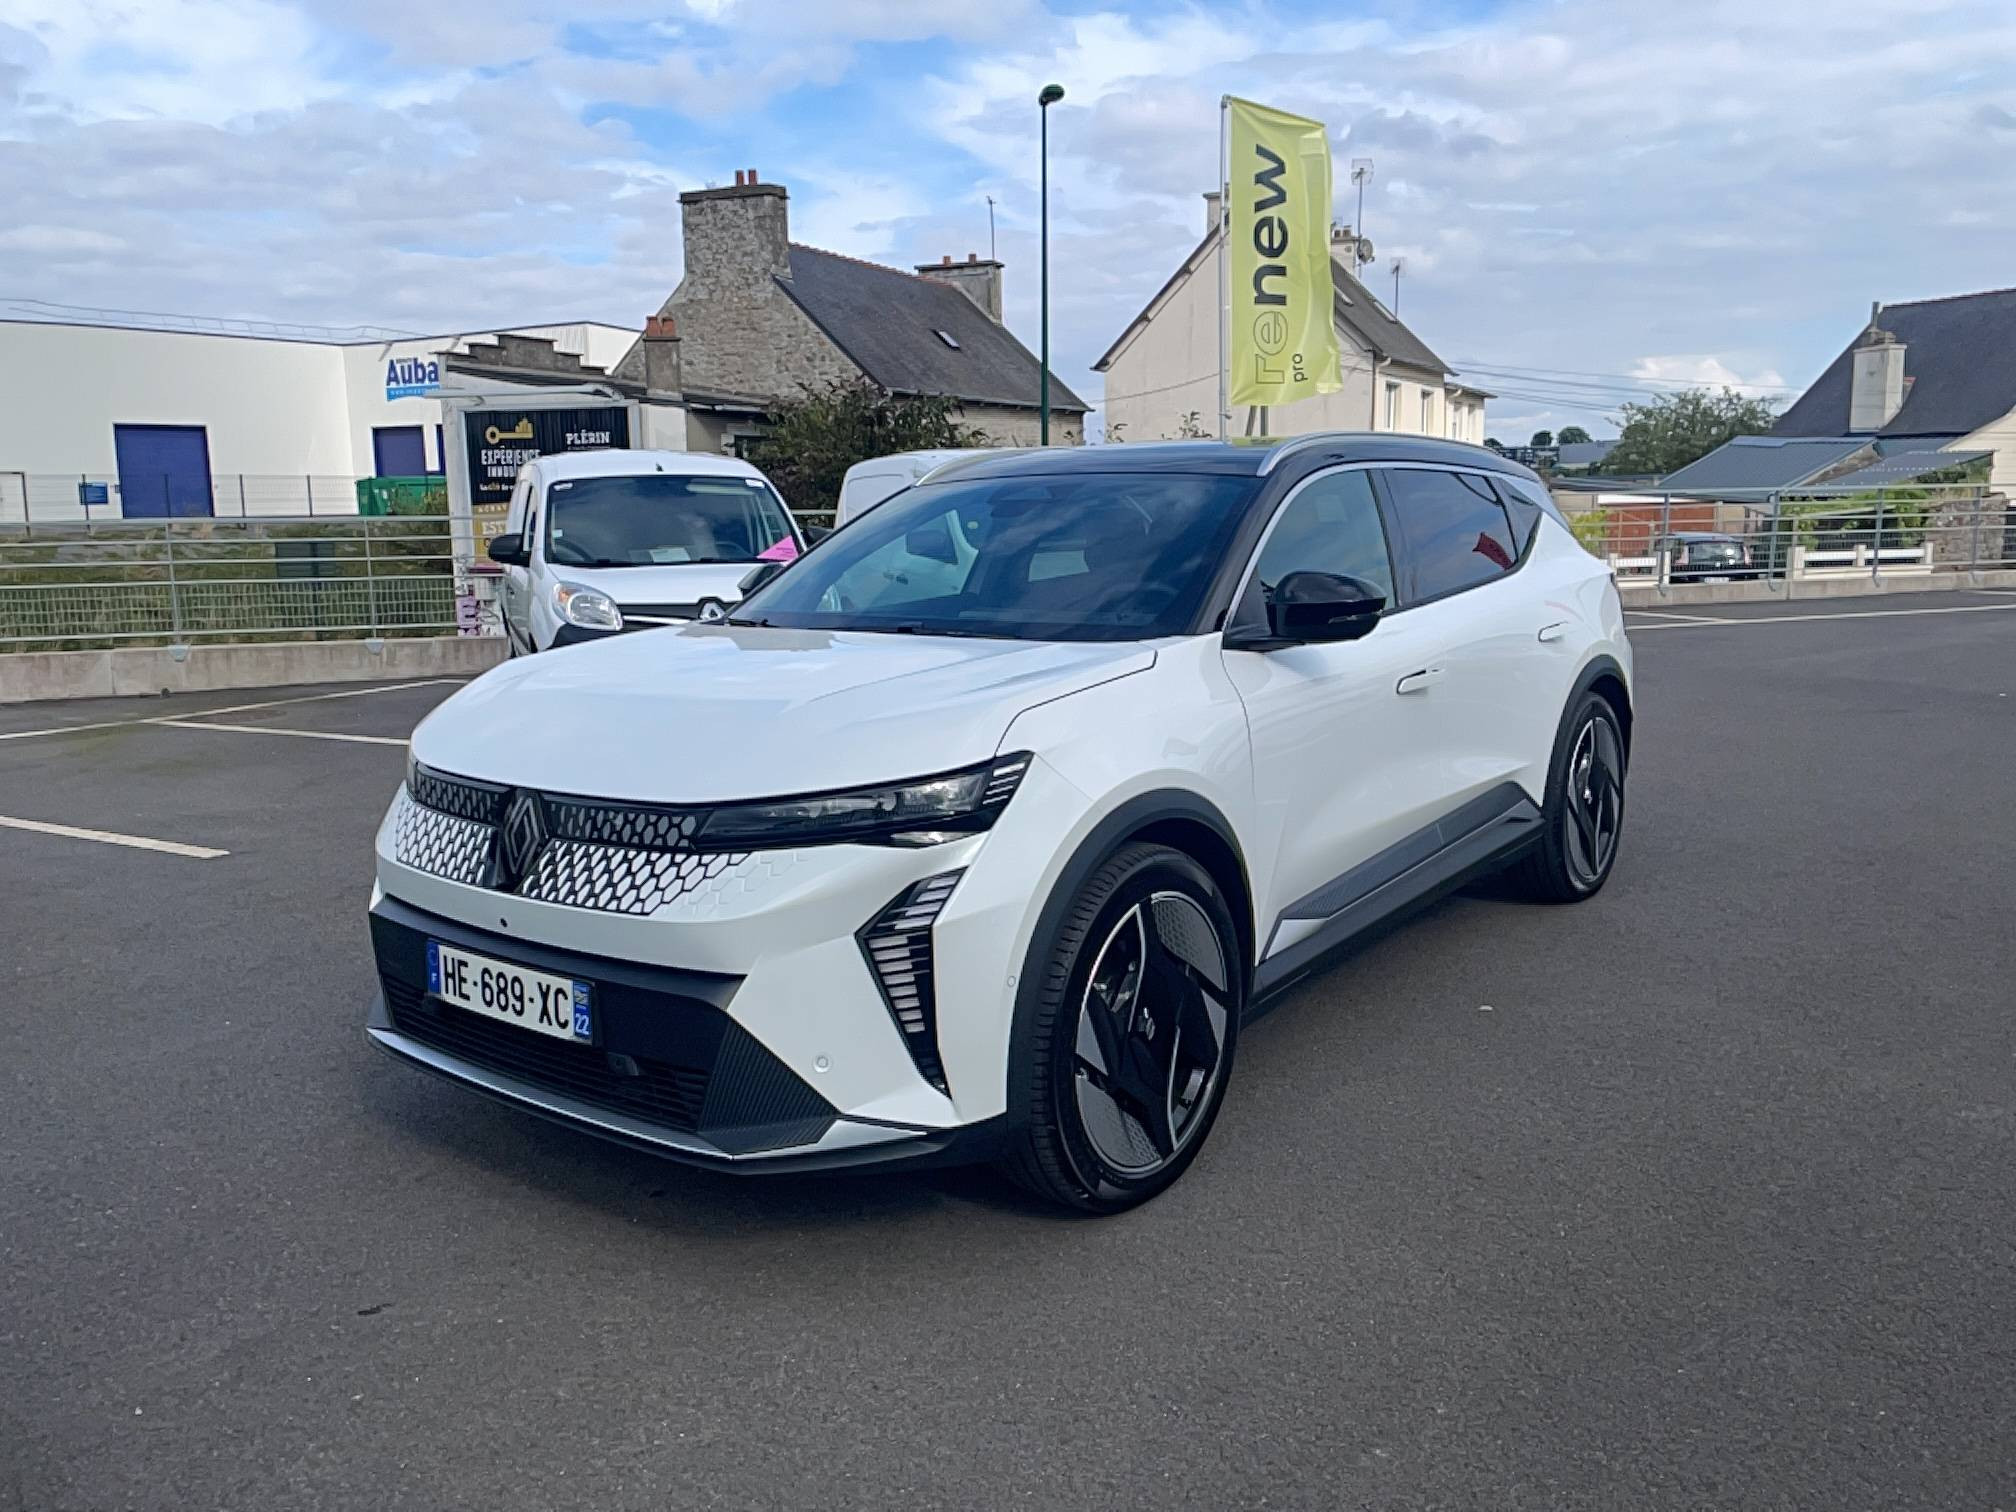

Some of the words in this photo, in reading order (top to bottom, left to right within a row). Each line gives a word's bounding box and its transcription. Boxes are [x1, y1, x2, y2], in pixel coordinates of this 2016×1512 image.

[1253, 143, 1288, 385] renew
[1292, 353, 1308, 383] pro
[565, 429, 611, 445] PLÉRIN
[431, 973, 438, 984] F
[443, 954, 569, 1030] HE-689-XC
[575, 1012, 590, 1035] 22
